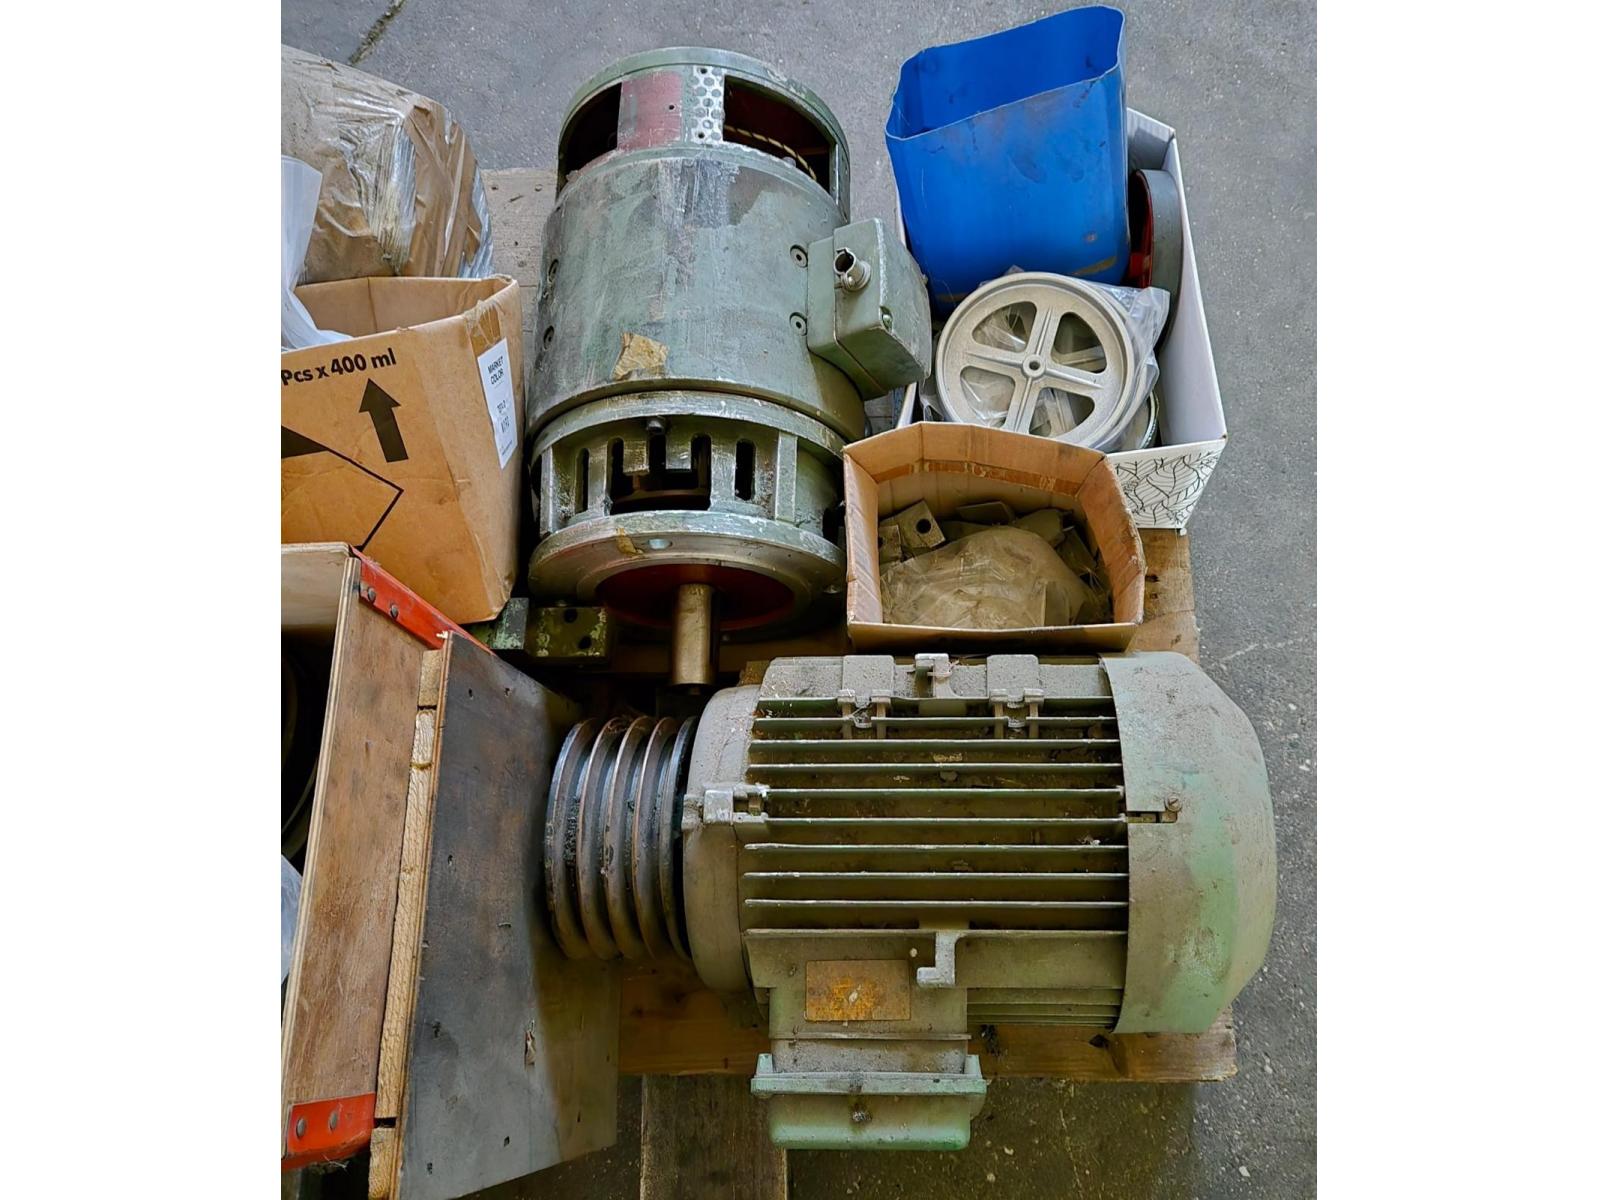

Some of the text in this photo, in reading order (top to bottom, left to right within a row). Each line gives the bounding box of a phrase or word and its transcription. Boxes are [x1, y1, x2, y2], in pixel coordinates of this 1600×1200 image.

[281, 347, 397, 386] Pcs x 400 ml
[487, 355, 504, 374] MARKET
[490, 368, 504, 385] COLOR
